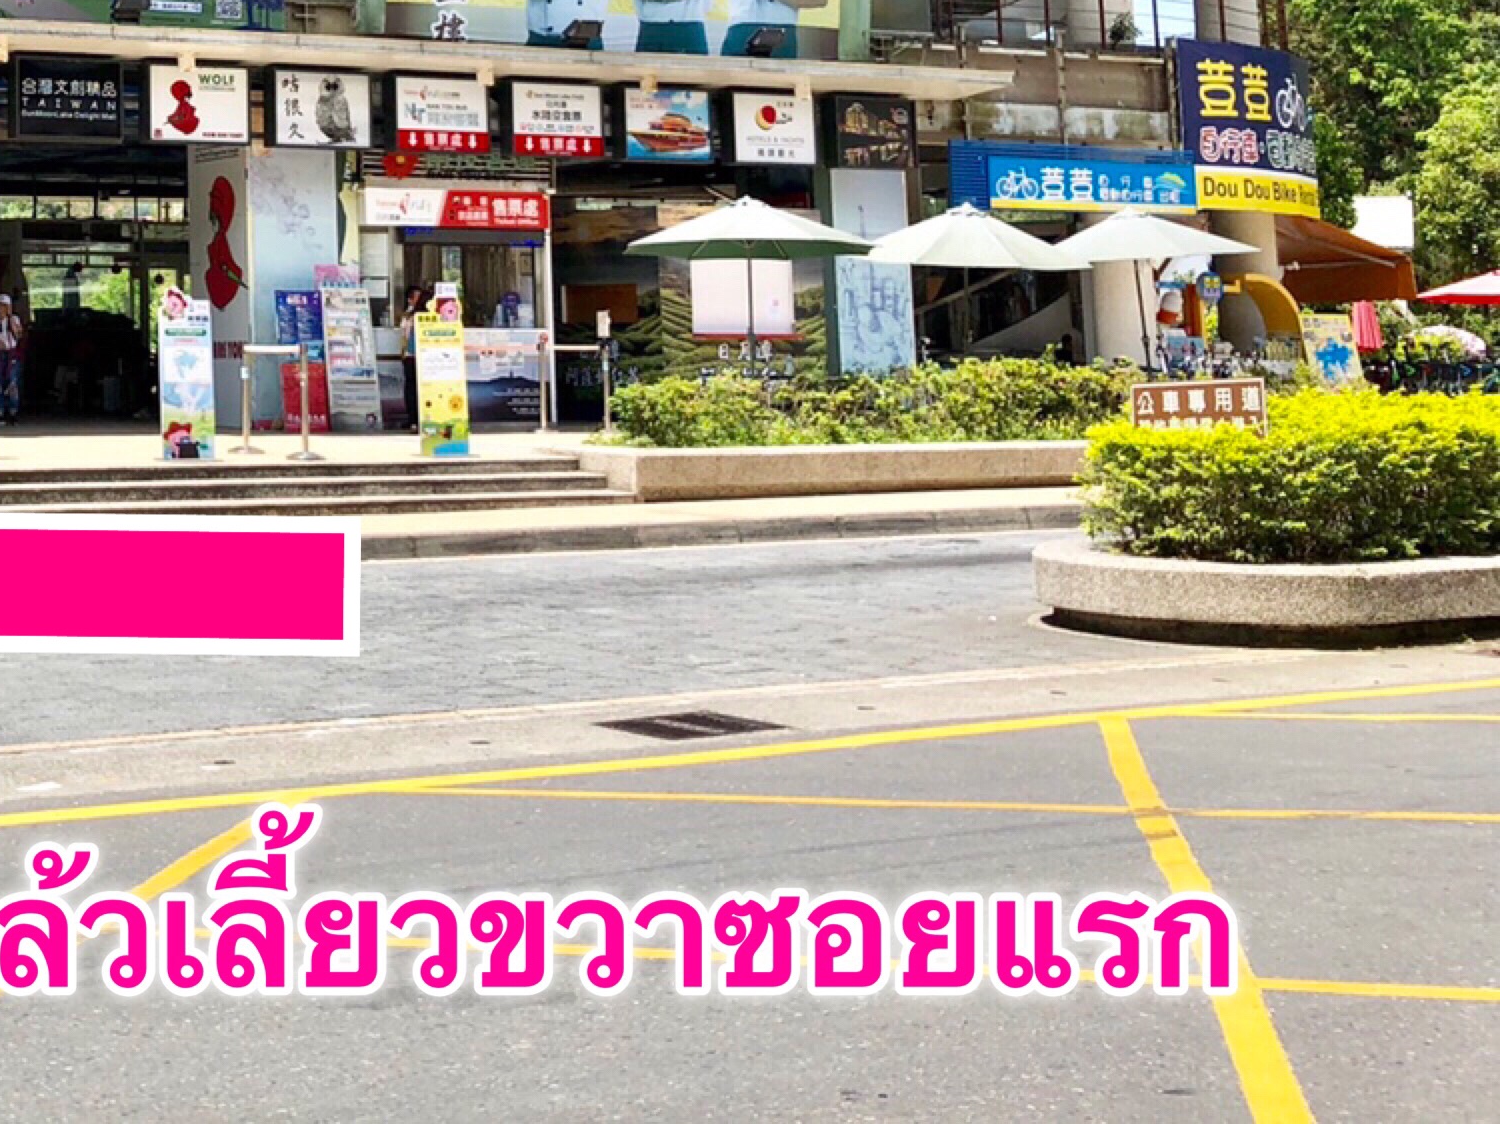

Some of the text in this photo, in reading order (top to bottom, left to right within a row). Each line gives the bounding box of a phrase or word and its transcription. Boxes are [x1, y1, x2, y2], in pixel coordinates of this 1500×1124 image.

[199, 73, 235, 85] WOLF
[1041, 167, 1097, 202] 荳荳
[1203, 178, 1239, 198] Dou
[1244, 181, 1270, 201] Dou
[1273, 183, 1297, 204] Bike
[1137, 386, 1261, 416] 公車專用道
